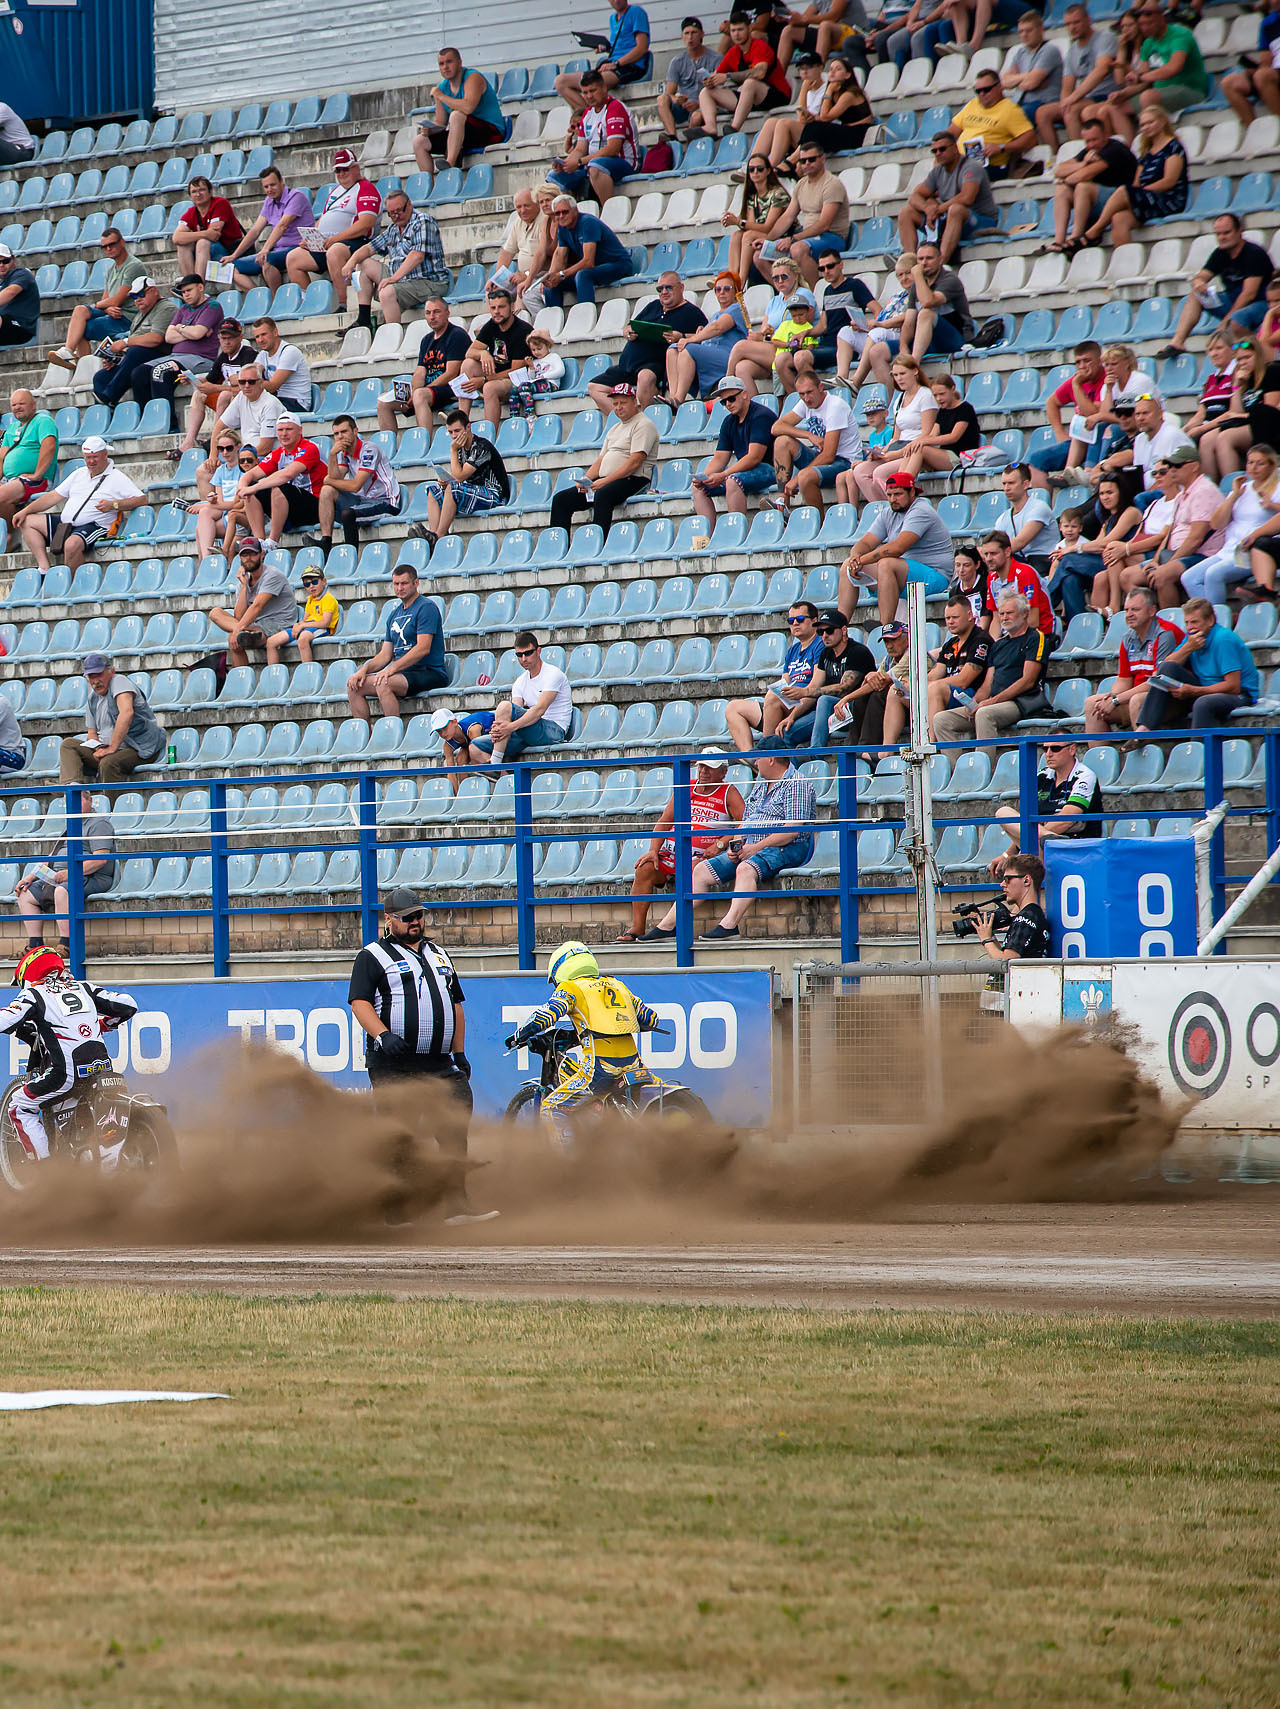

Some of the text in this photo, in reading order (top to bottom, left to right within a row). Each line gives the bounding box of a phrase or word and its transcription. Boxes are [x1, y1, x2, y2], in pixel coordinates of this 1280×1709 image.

[801, 509, 809, 519] 22
[838, 507, 846, 516] 21
[711, 578, 719, 587] 22
[747, 575, 754, 584] 21
[673, 582, 682, 591] 23
[713, 702, 721, 712] 17
[1186, 745, 1192, 754] 3
[1100, 750, 1105, 759] 5
[619, 774, 627, 783] 17
[958, 826, 962, 835] 6
[1131, 822, 1136, 831] 2
[1174, 823, 1179, 832] 1
[607, 988, 621, 1006] 2
[63, 993, 83, 1013] 9
